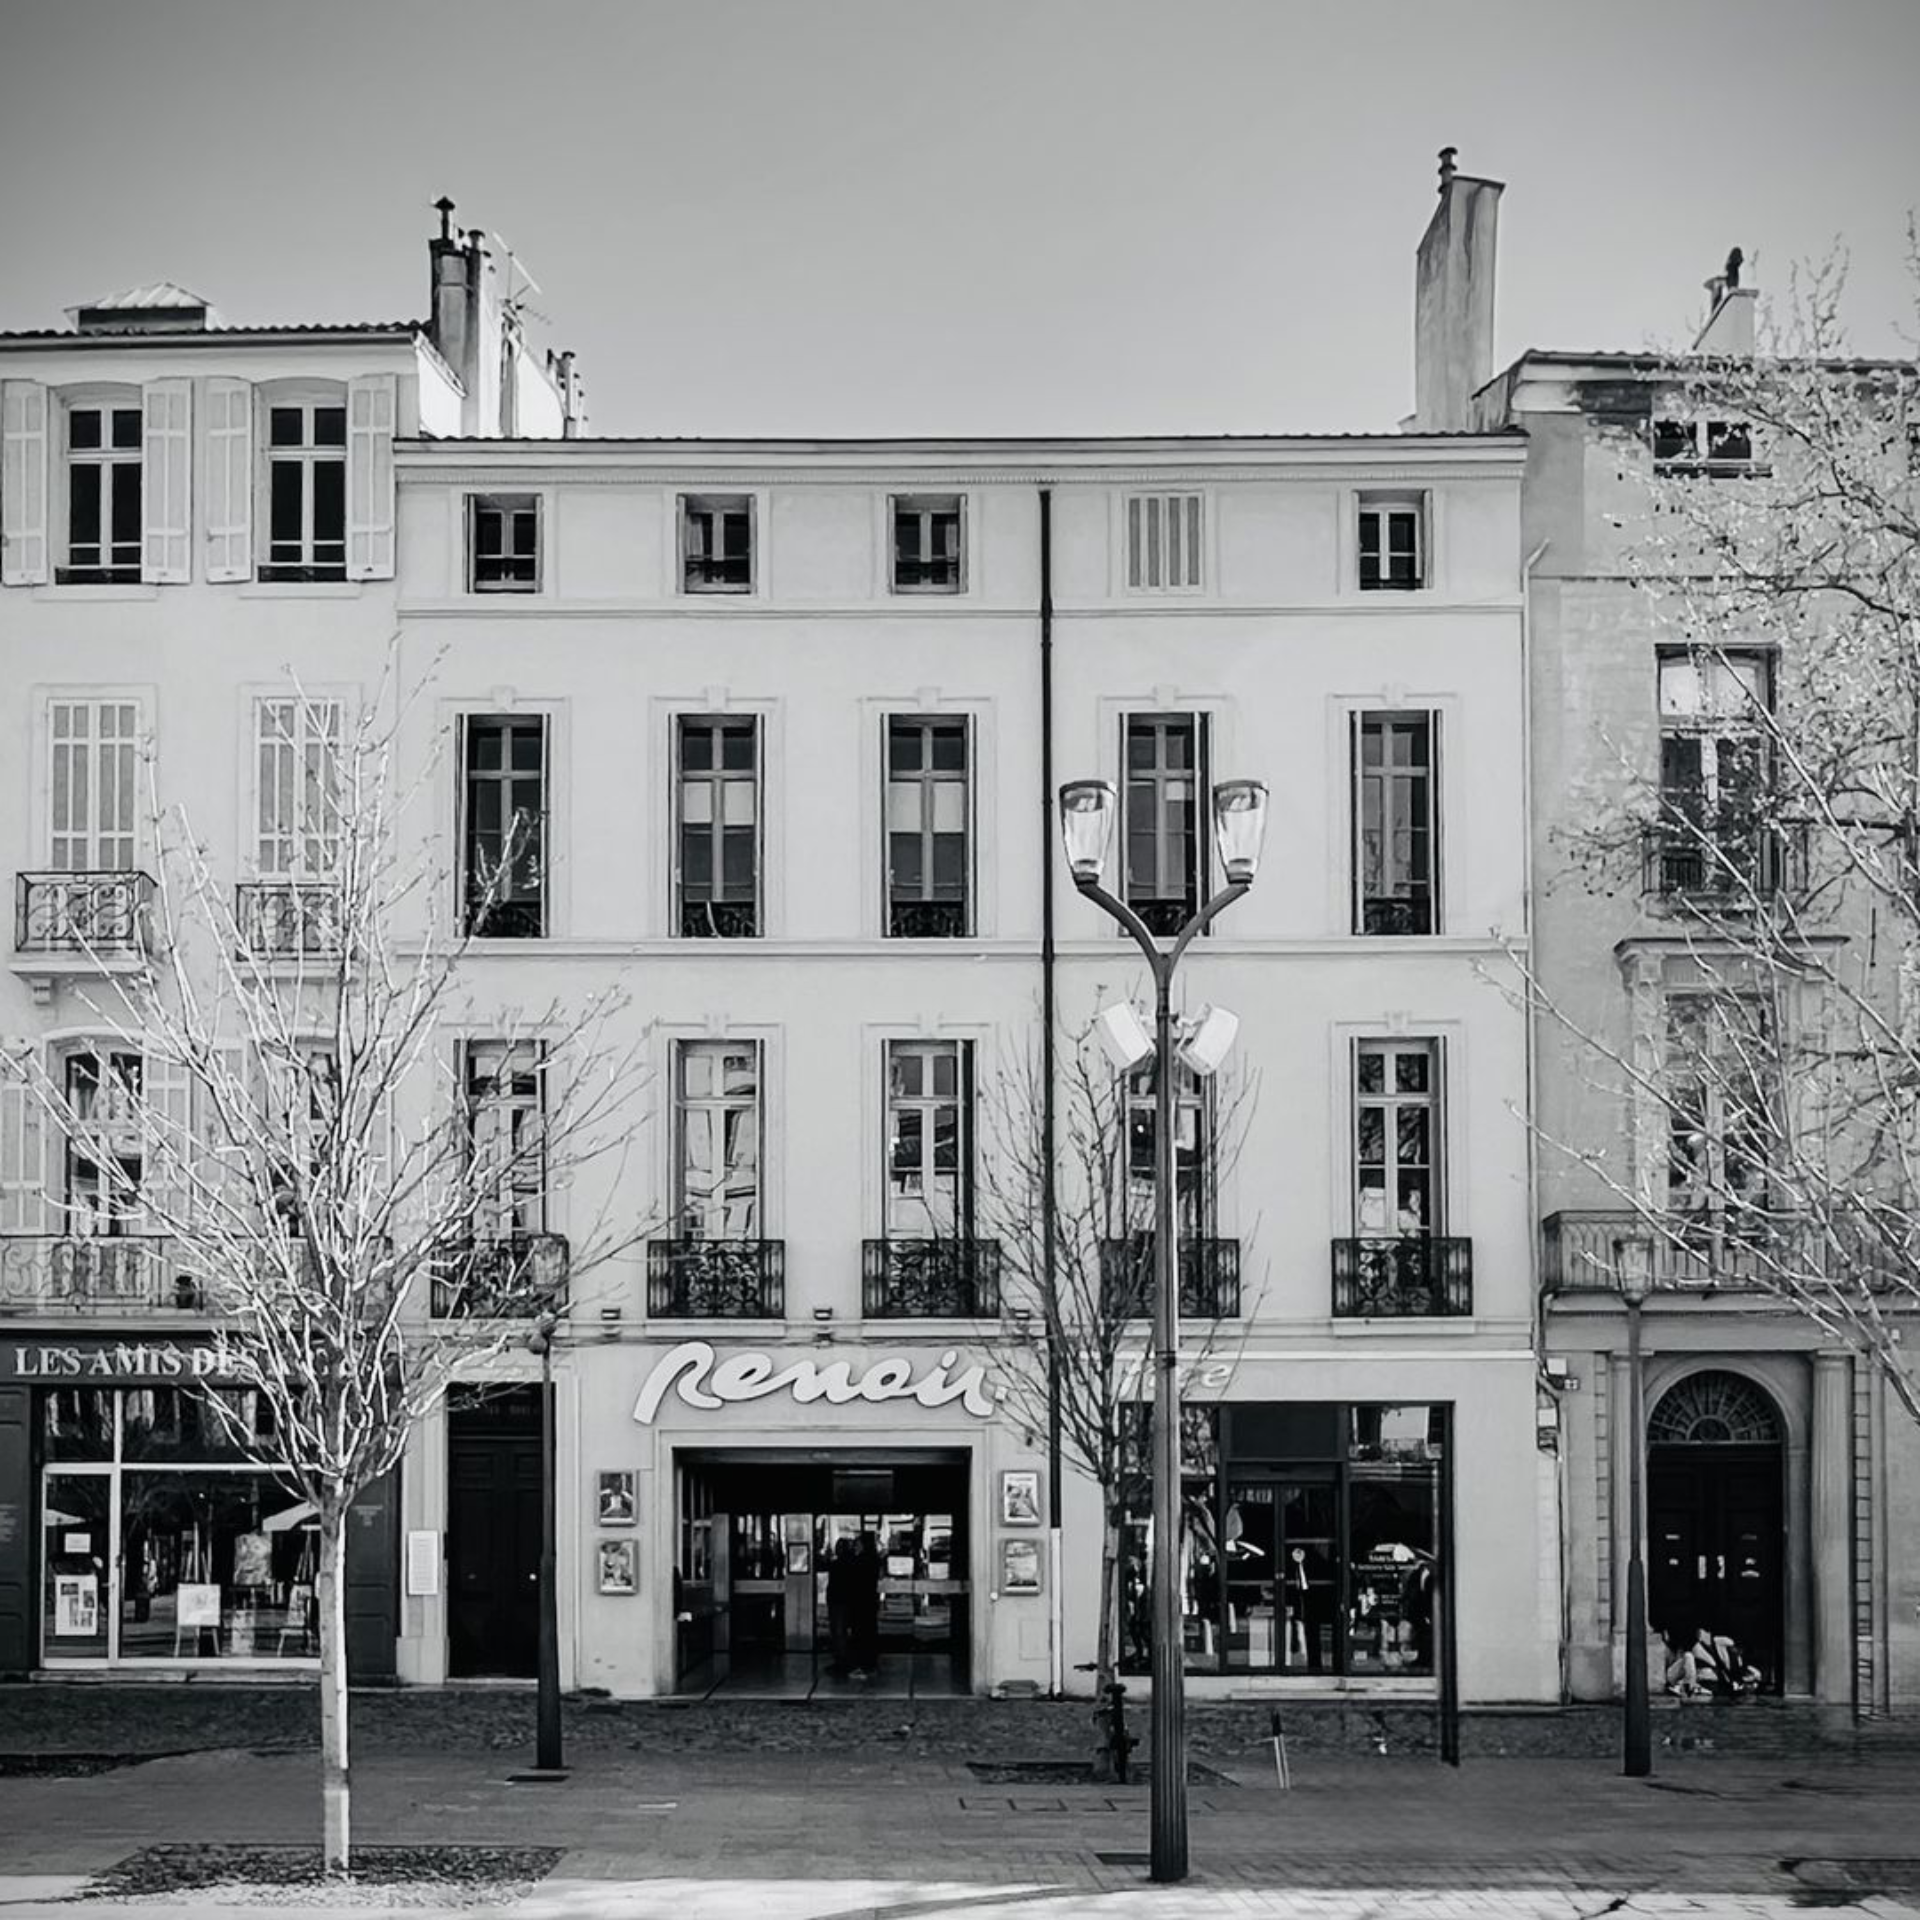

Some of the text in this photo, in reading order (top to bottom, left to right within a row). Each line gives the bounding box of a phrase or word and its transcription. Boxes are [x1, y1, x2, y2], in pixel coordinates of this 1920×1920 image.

[14, 1347, 82, 1376] LES
[88, 1347, 183, 1376] AMIS
[633, 1341, 996, 1425] Renoir
